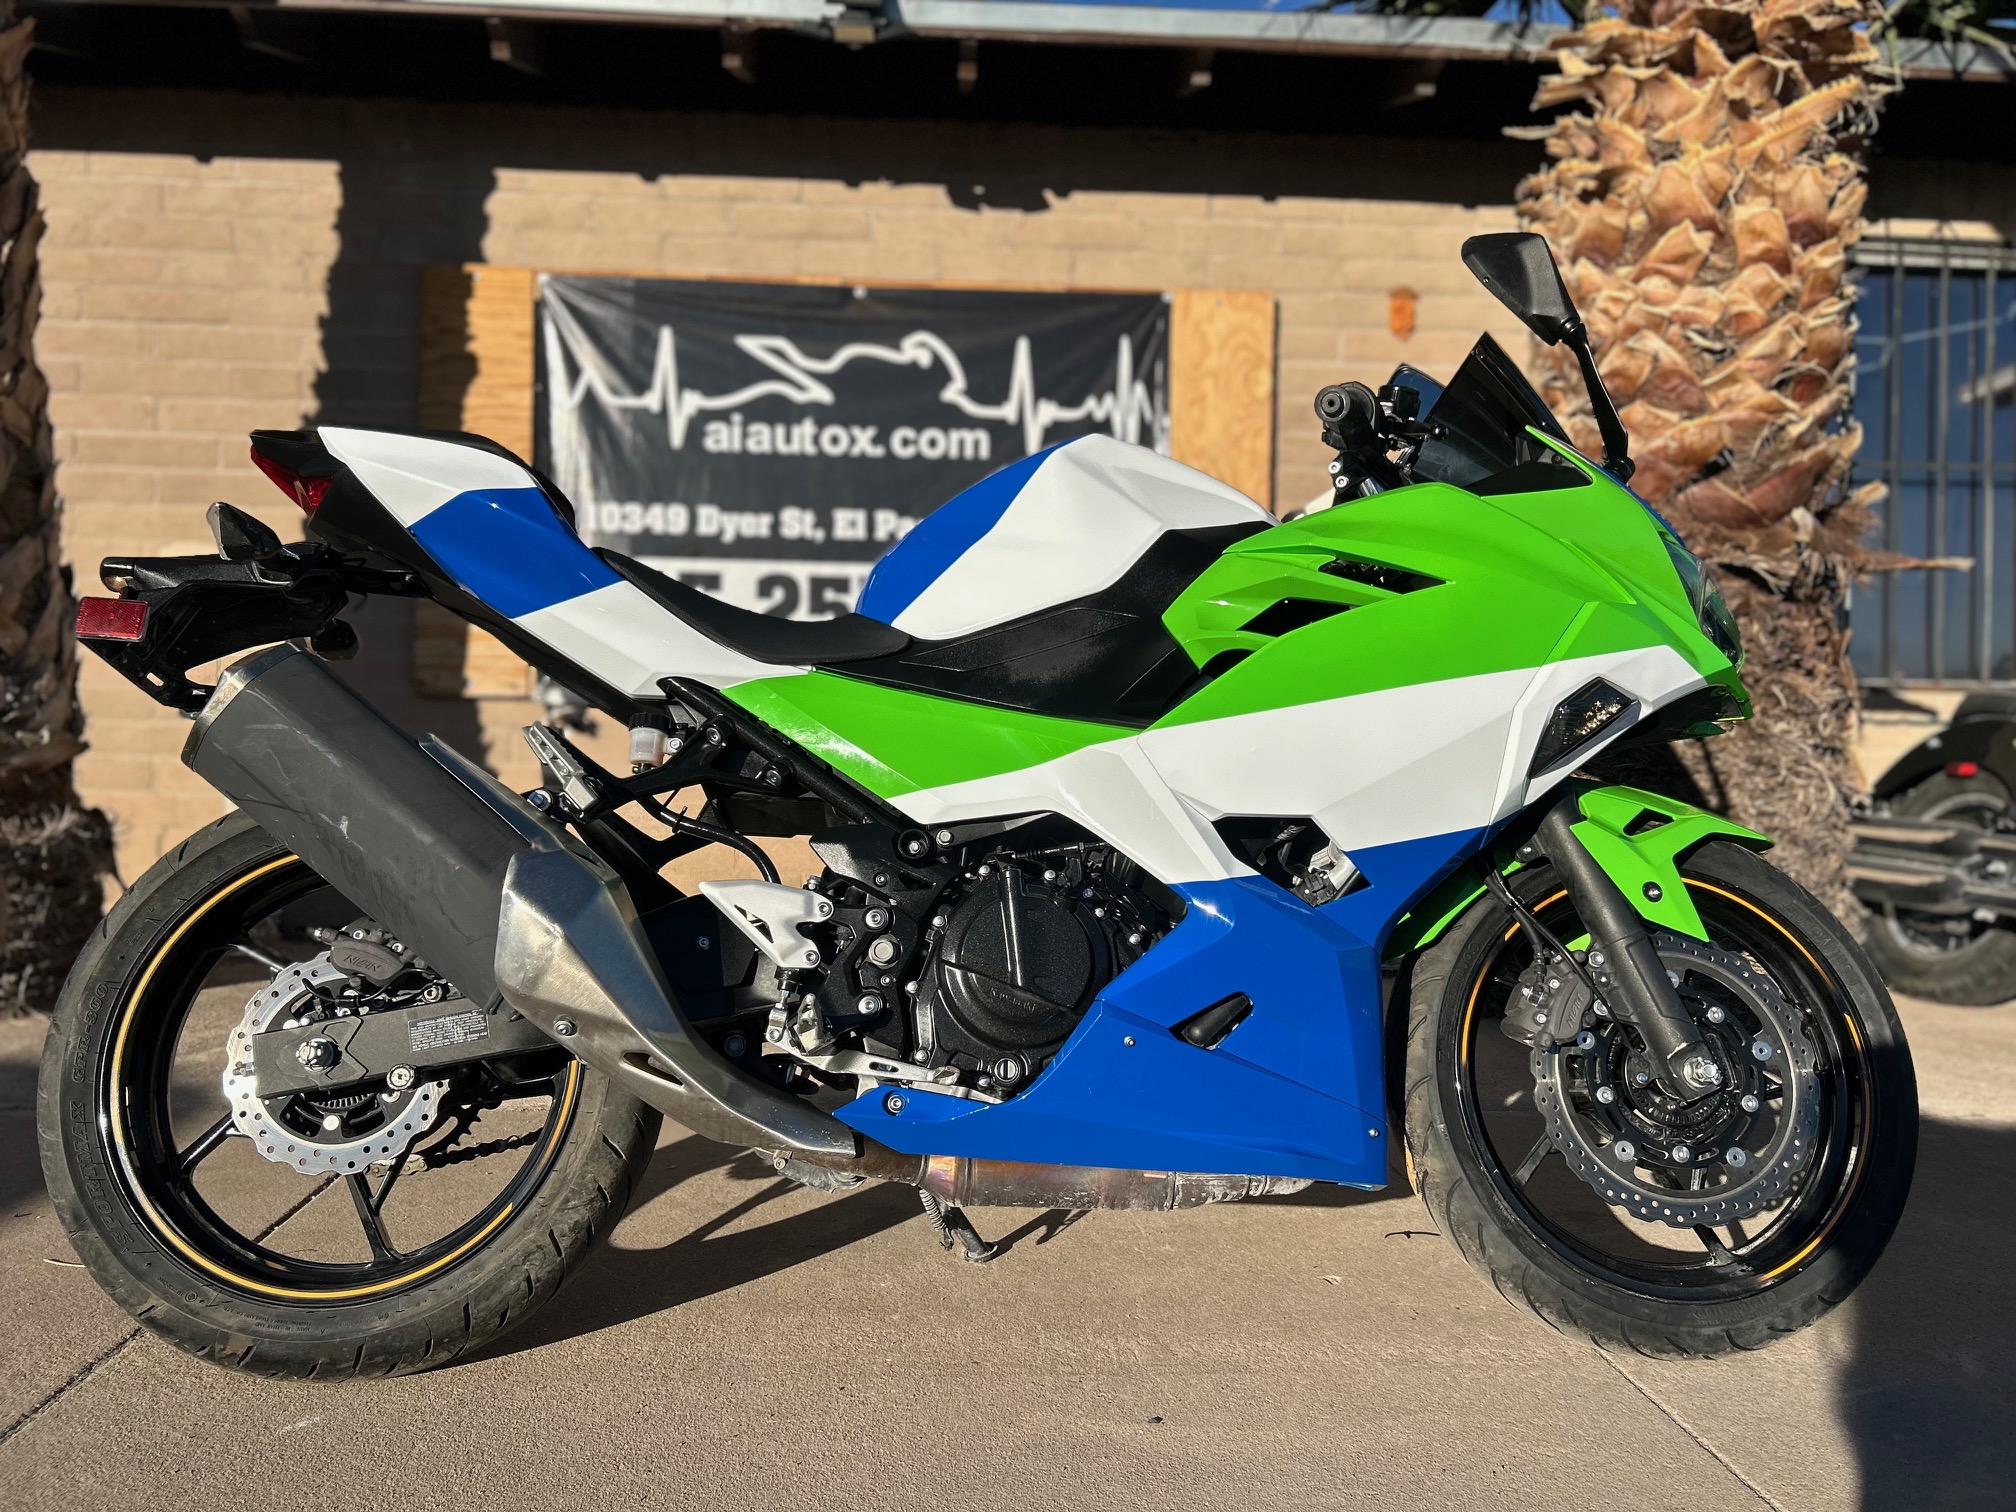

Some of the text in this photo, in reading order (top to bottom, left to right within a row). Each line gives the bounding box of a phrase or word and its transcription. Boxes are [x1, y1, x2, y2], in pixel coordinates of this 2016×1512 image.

[702, 412, 992, 461] aiautox.com
[587, 501, 691, 536] 10349
[694, 503, 775, 544] Dyer
[778, 505, 826, 545] St,
[830, 508, 868, 541] El
